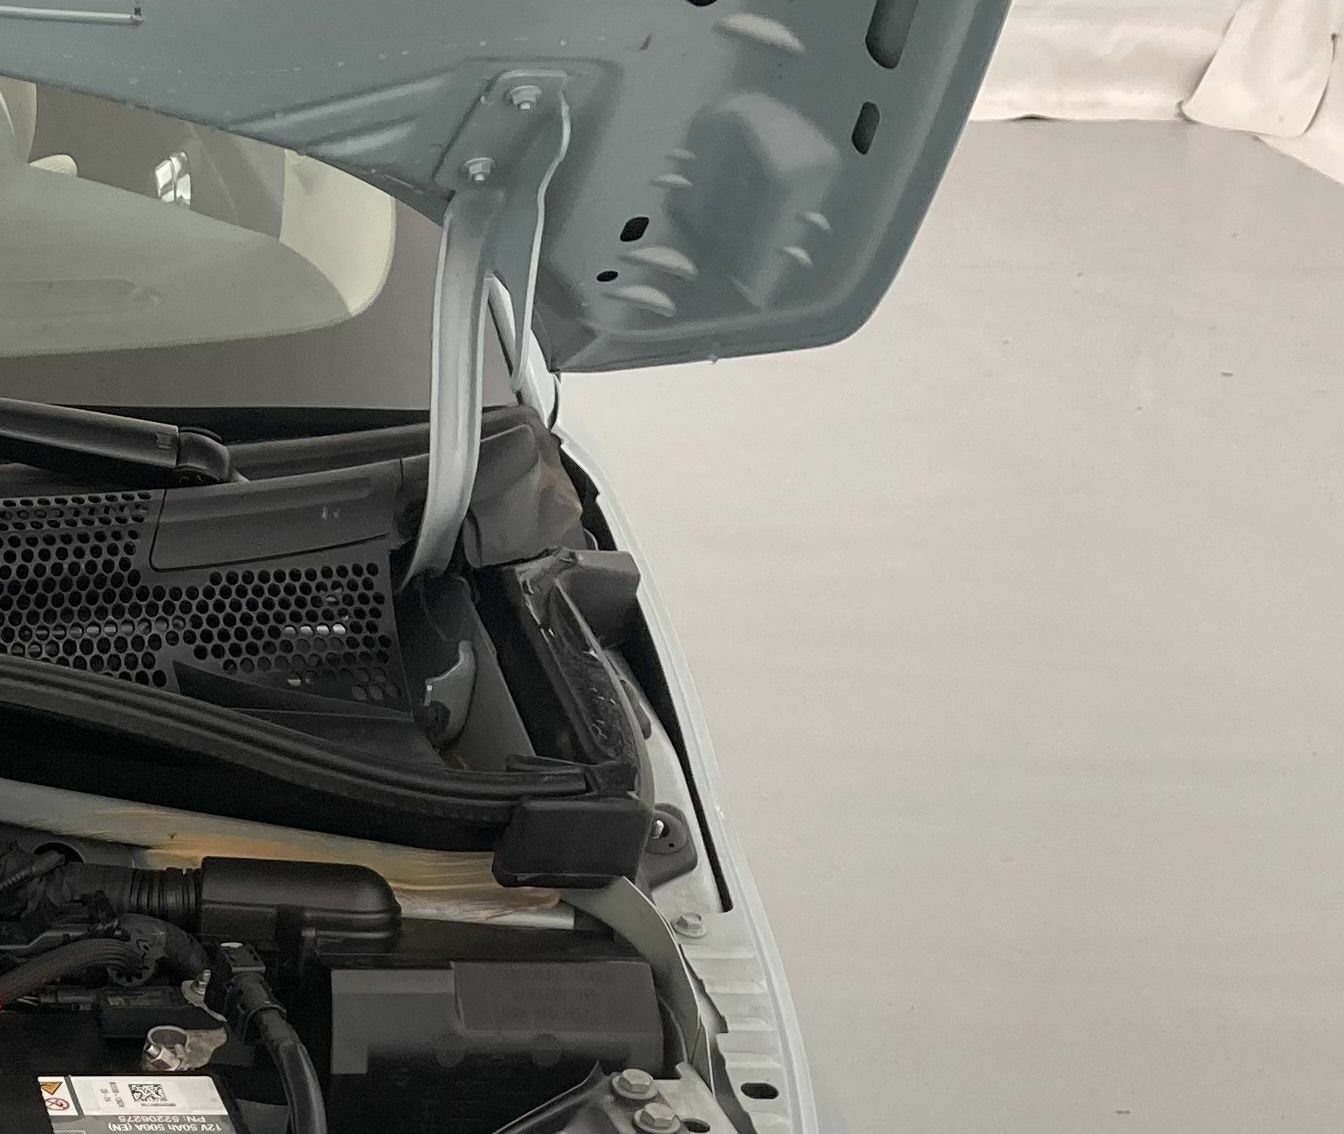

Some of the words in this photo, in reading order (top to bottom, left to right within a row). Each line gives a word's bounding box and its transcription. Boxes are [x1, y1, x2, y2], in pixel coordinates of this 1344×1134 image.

[107, 1122, 132, 1132] (EN)
[136, 1123, 165, 1131] 500A
[168, 1123, 198, 1132] 50Ah
[201, 1123, 222, 1131] 12V
